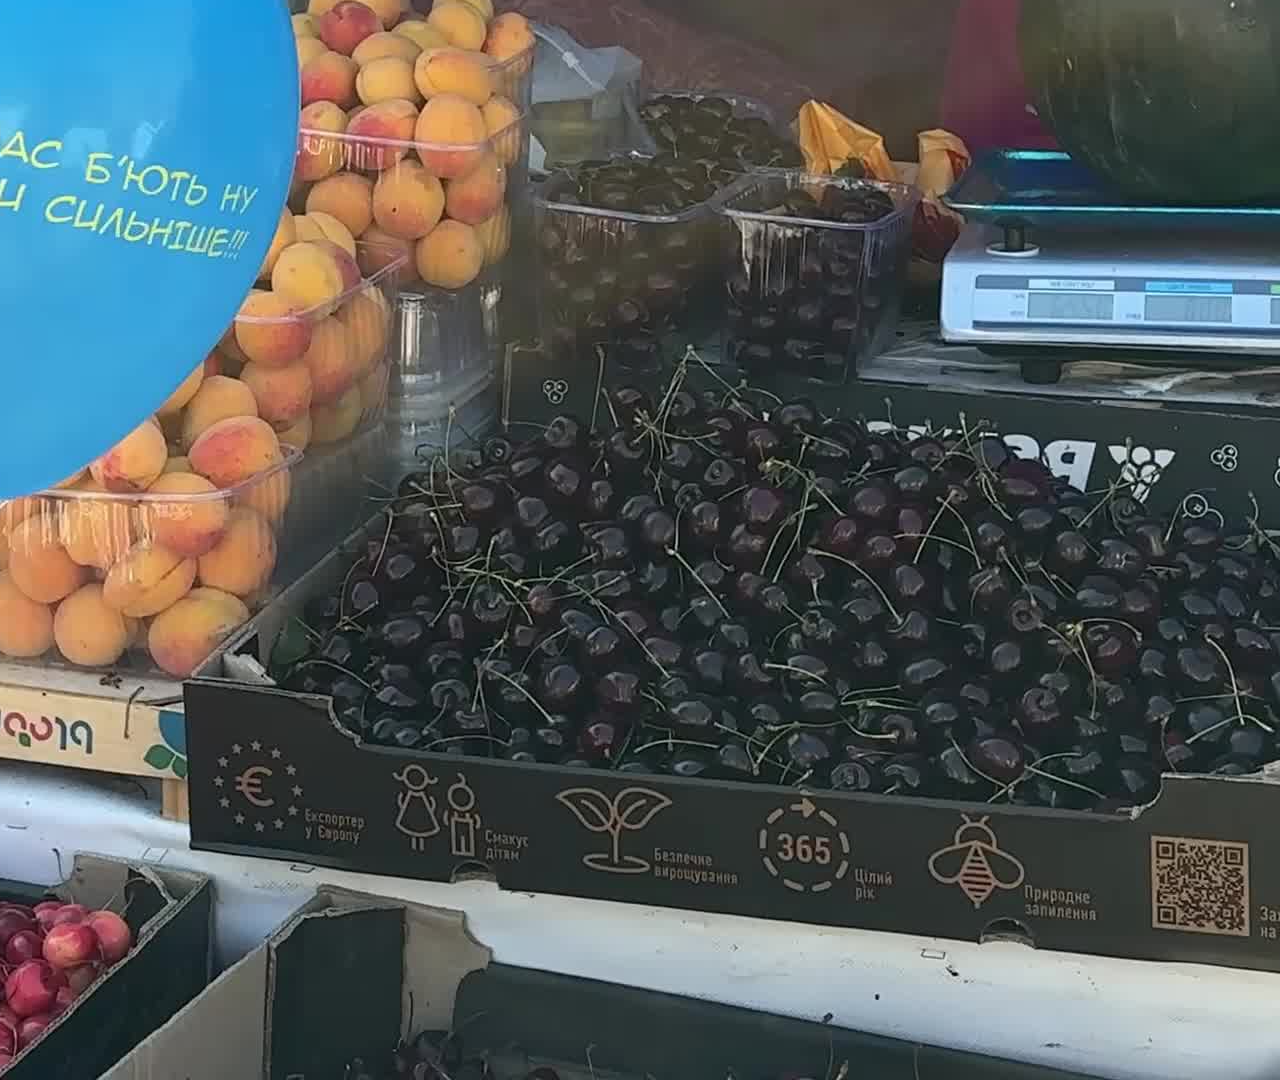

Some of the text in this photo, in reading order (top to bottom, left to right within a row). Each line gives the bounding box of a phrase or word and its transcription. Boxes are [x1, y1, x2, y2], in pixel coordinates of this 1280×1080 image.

[84, 151, 208, 207] Б'ЮТЬ
[219, 182, 259, 215] НУ
[43, 194, 251, 261] СИЛЬНІШЕ!!!
[304, 808, 366, 829] Експортер
[654, 847, 713, 867] Безпечне
[777, 832, 832, 866] 365
[654, 866, 738, 886] вирощування
[854, 867, 893, 886] Цілий
[855, 885, 876, 902] рік
[1024, 884, 1091, 905] Природне
[1025, 902, 1097, 921] запилення
[1260, 924, 1277, 939] на
